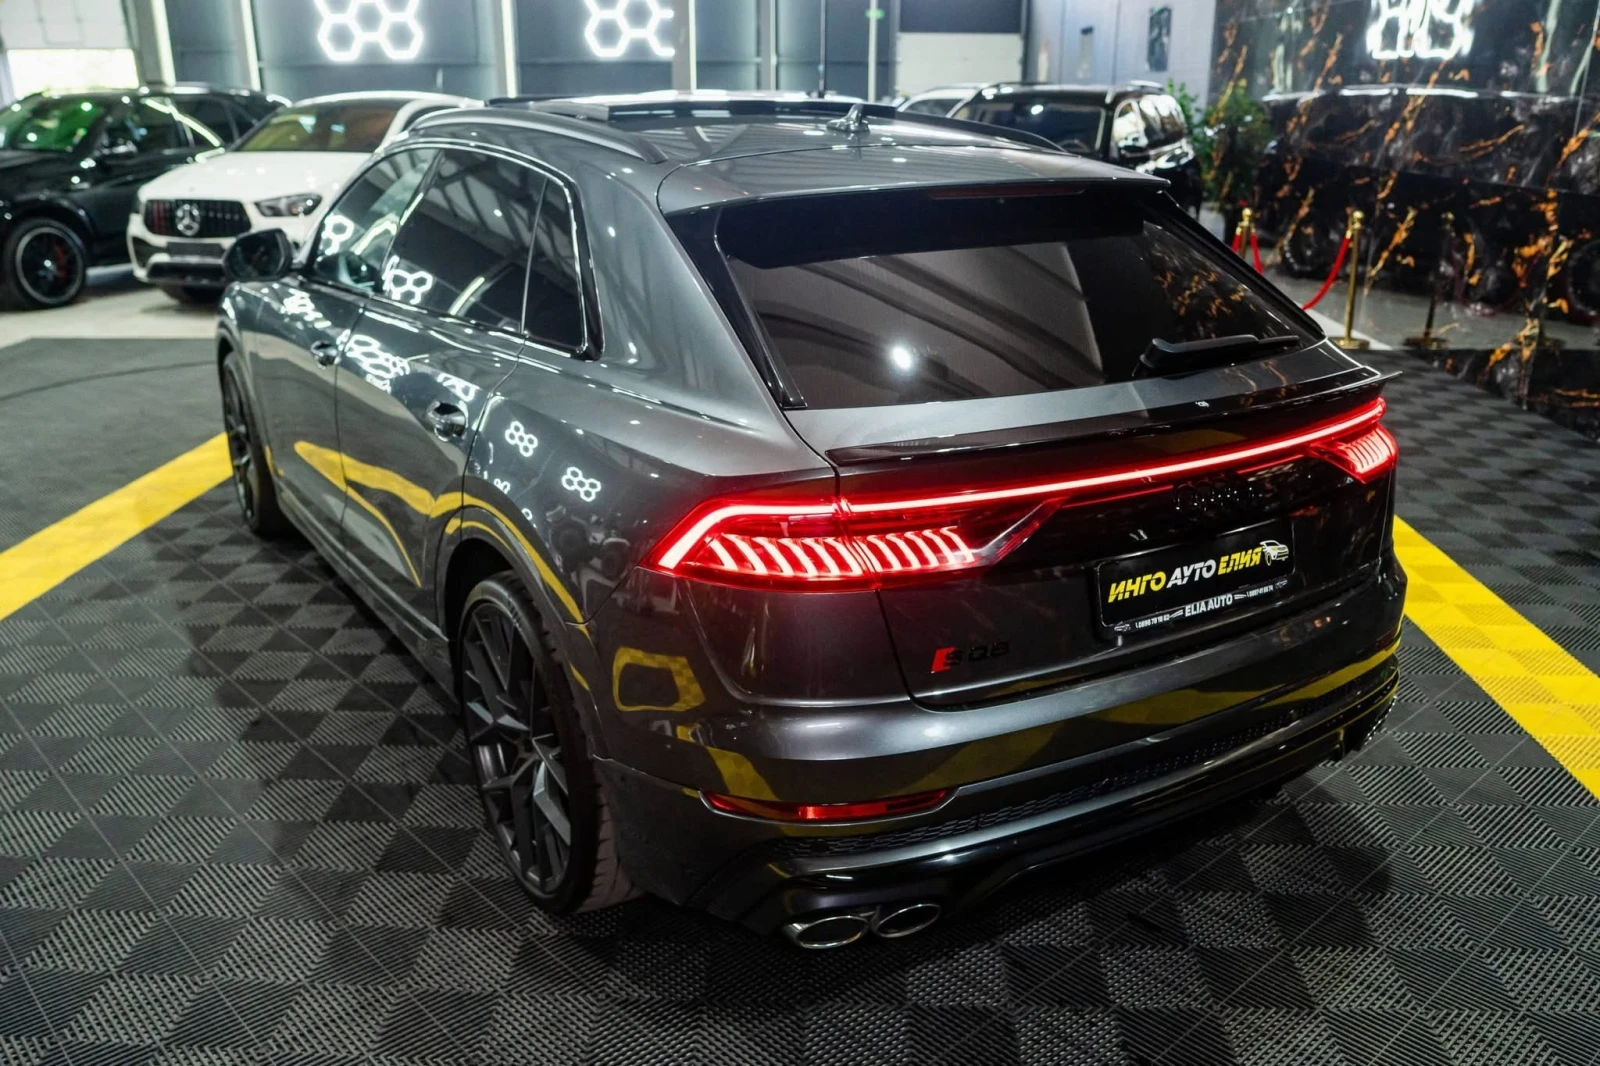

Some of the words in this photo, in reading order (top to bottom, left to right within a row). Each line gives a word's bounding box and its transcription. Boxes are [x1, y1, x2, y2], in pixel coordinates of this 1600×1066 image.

[1107, 571, 1167, 603] ИНГО
[1166, 559, 1217, 589] АУТО
[1217, 546, 1263, 576] ЕЛИЯ
[1185, 600, 1207, 617] ELIA
[1206, 593, 1233, 611] AUTO
